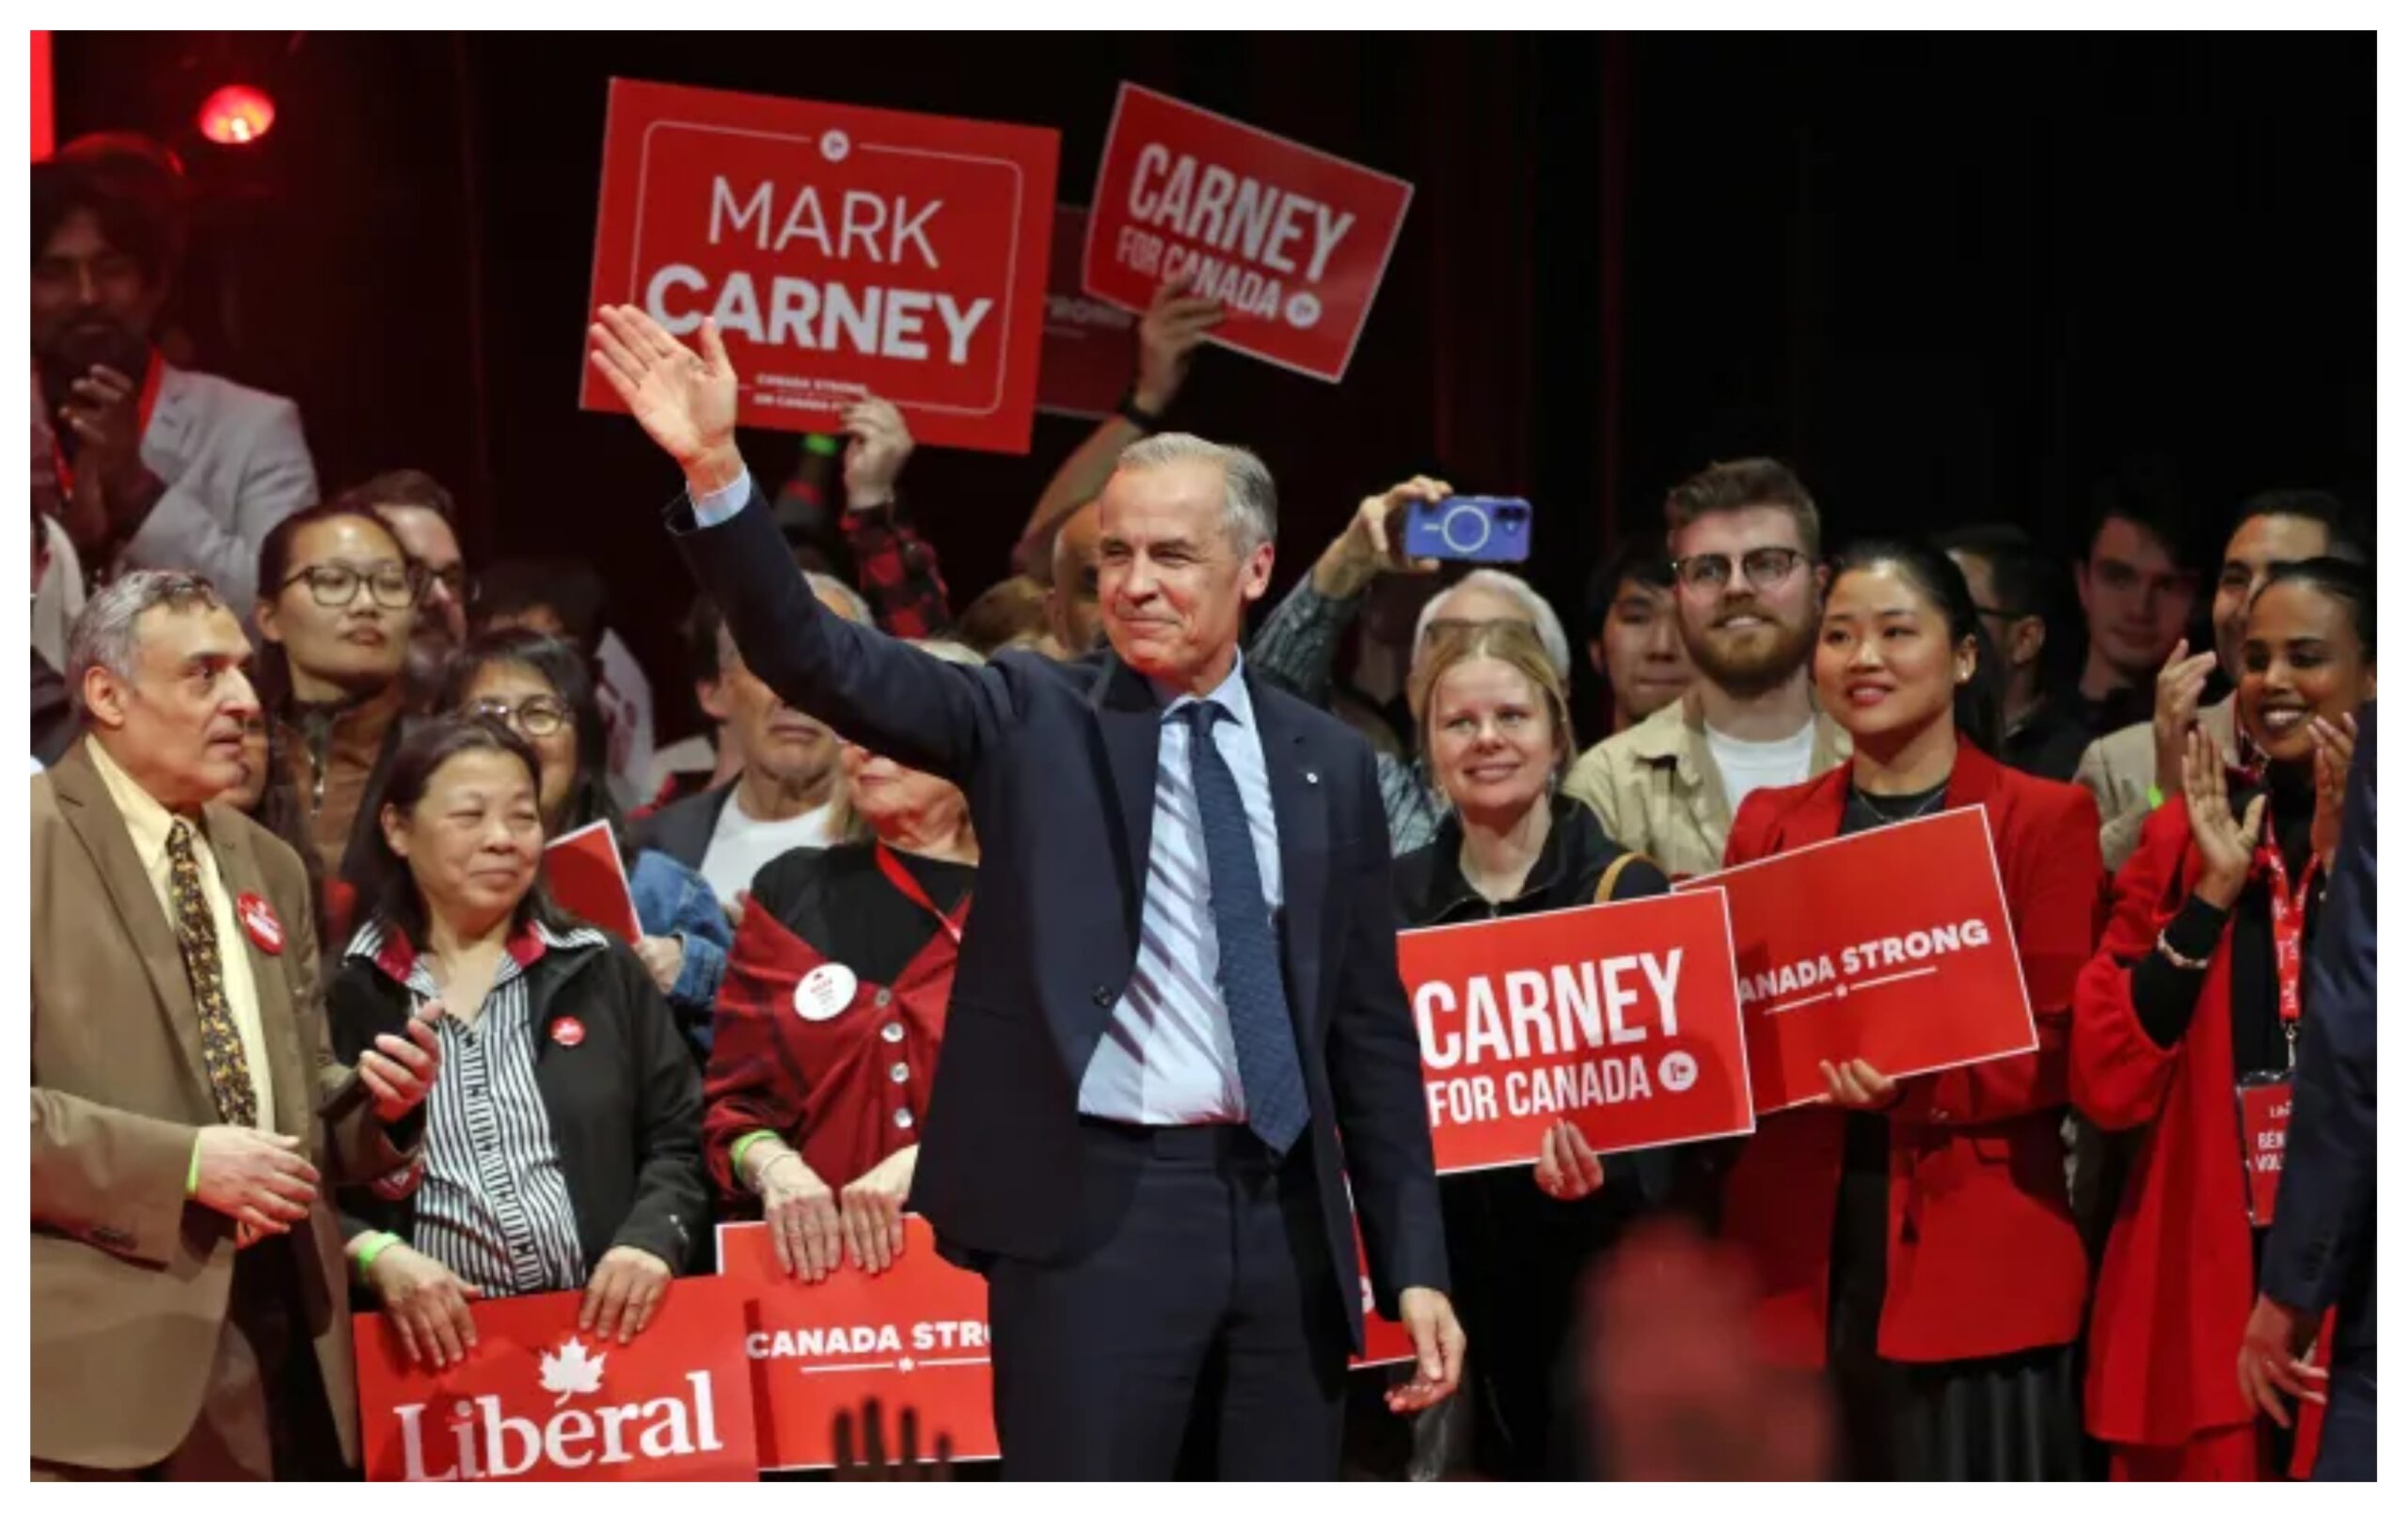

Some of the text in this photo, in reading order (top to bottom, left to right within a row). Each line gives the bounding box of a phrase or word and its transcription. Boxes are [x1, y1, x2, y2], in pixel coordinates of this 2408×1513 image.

[708, 175, 943, 269] MARK
[1116, 224, 1164, 278] FOR
[1128, 143, 1356, 282] CARNEY
[645, 263, 993, 365] CARNEY
[1739, 918, 1991, 1004] ANADA STRONG
[1414, 946, 1684, 1070] CARNEY
[1425, 1053, 1653, 1128] FOR CANADA
[745, 1318, 991, 1360] CANADA STR
